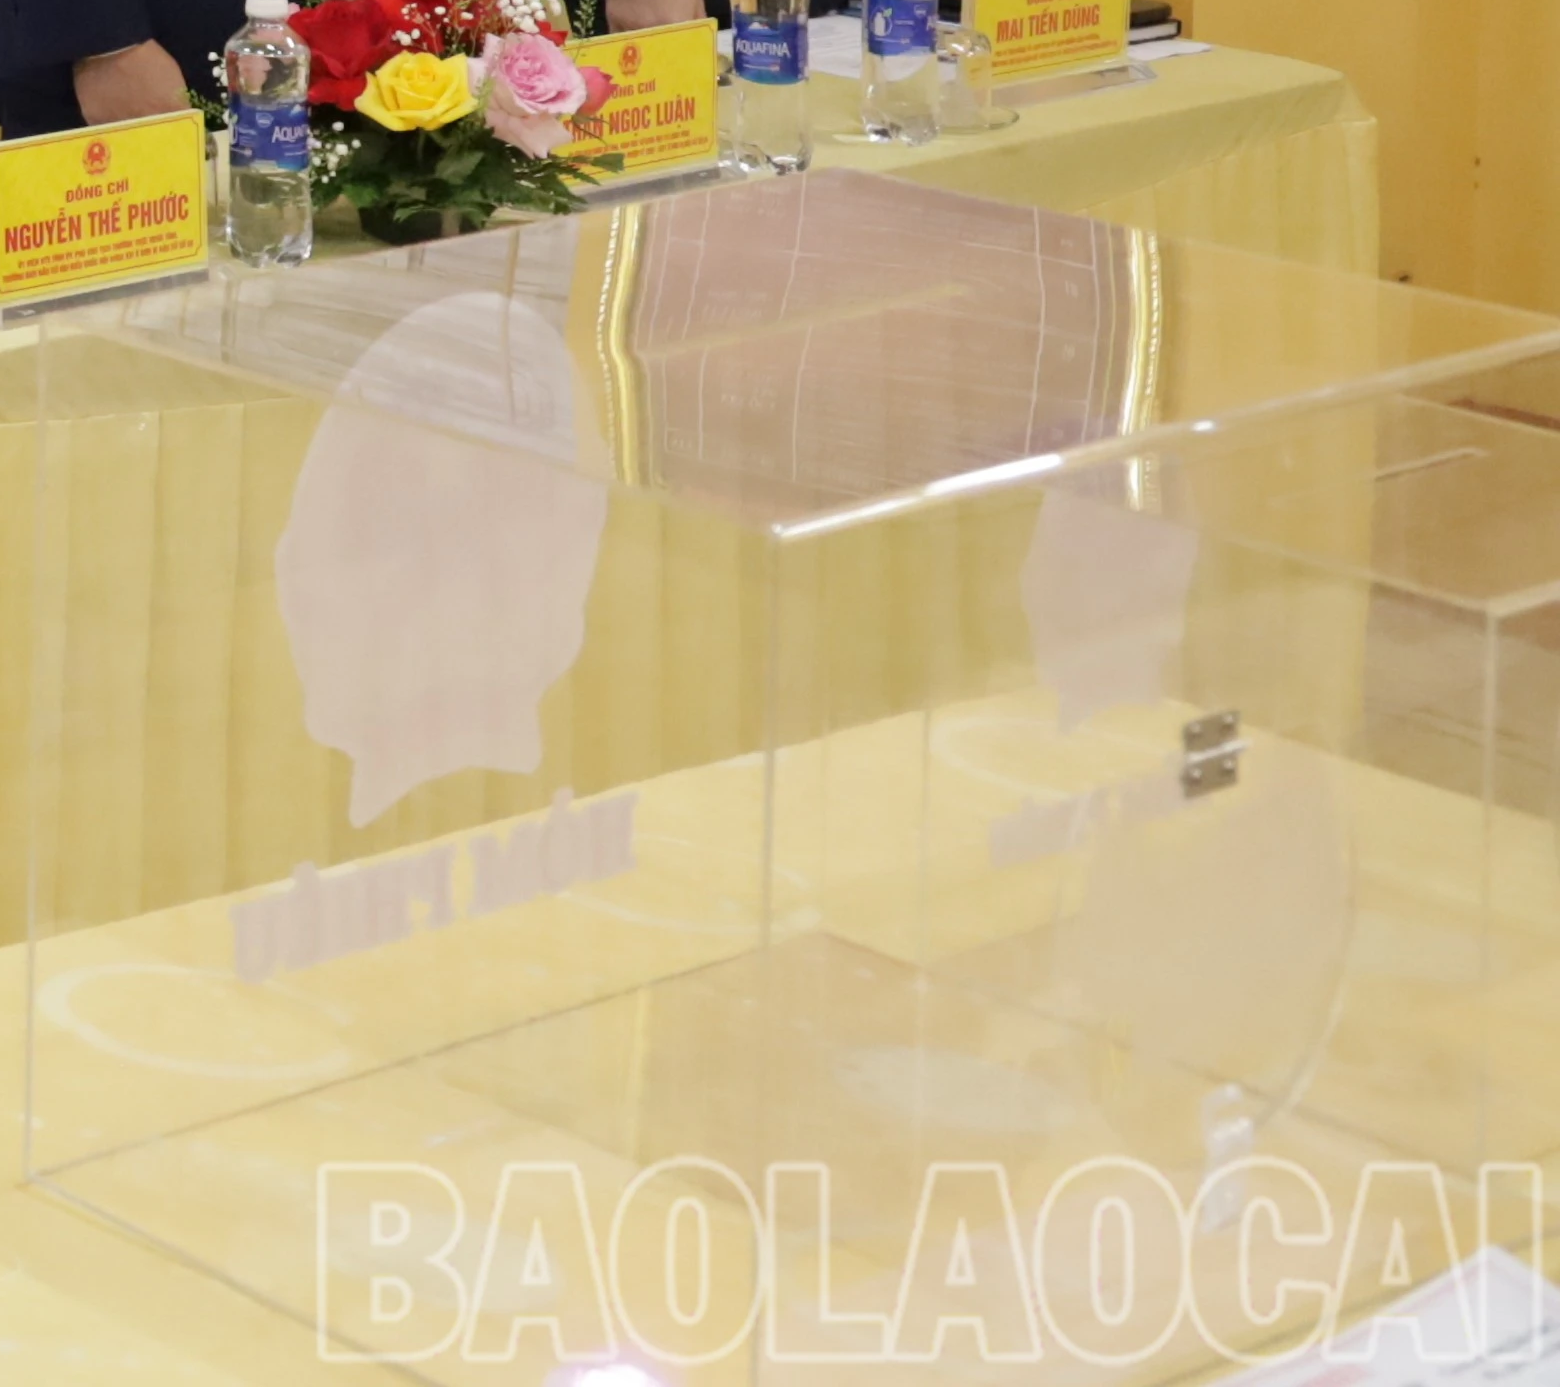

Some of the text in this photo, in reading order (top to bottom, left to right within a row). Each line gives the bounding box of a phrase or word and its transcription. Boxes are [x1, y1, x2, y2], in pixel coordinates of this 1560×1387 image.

[996, 4, 1100, 43] MAI TIẾN DŨNG
[736, 38, 791, 58] AQUAFINA
[638, 79, 656, 94] CHÍ
[609, 105, 651, 137] NGỌC
[656, 94, 696, 129] LUẬN
[65, 177, 129, 203] ĐỒNG CHÍ
[4, 191, 189, 254] NGUYỄN THẾ PHƯỚC
